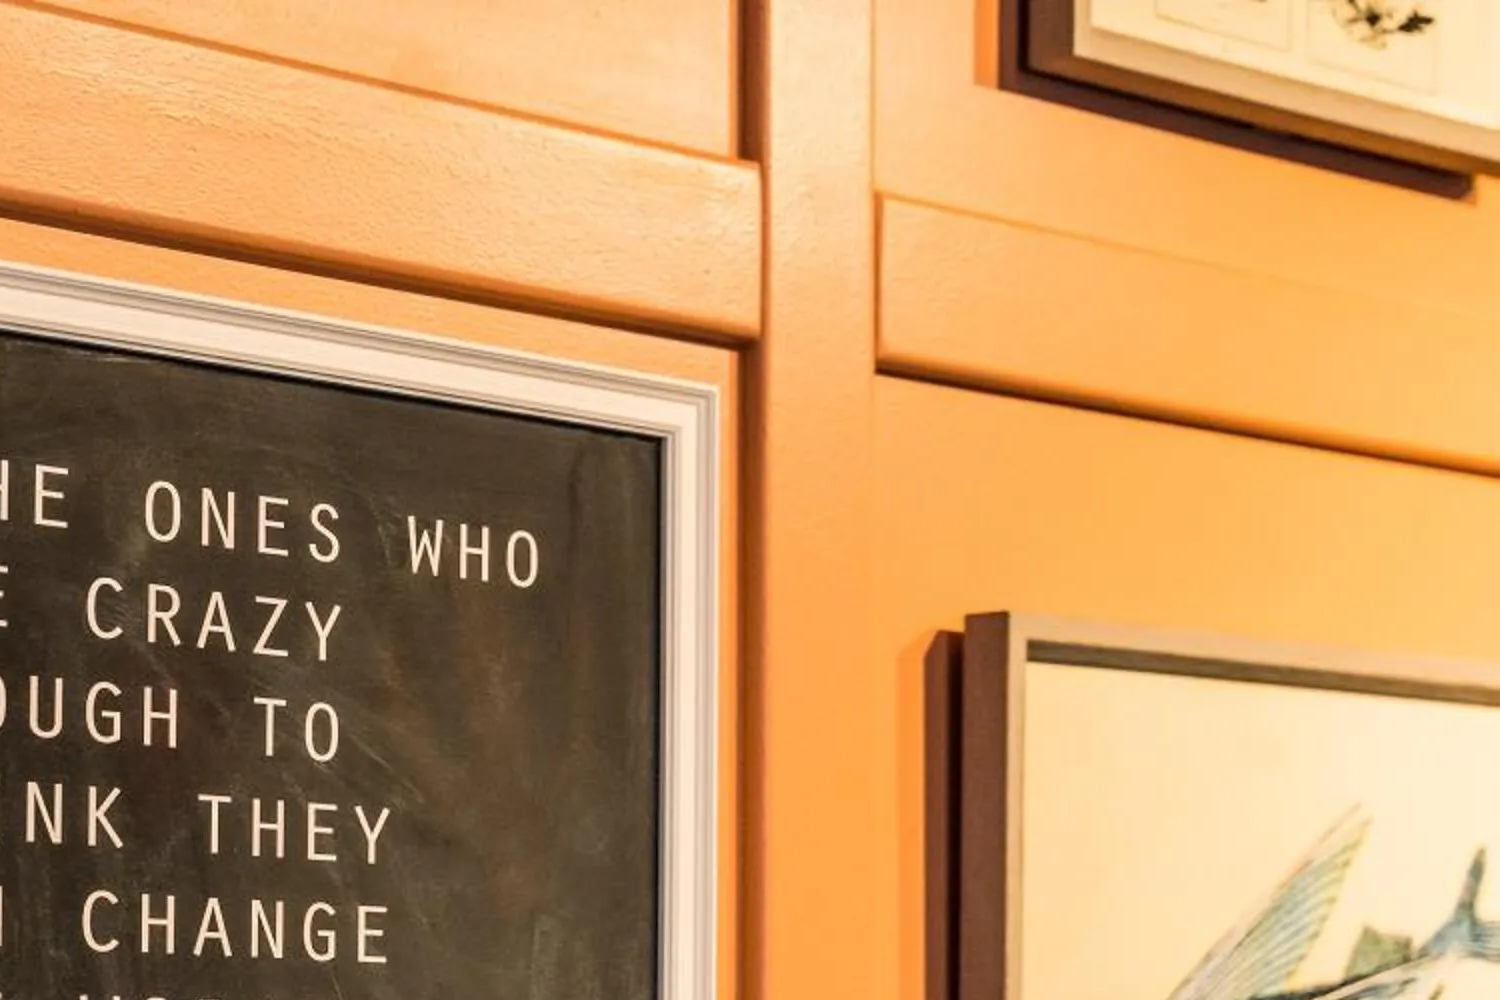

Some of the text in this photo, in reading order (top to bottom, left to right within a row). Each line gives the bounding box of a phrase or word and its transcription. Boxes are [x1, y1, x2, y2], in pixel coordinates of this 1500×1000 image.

[144, 480, 341, 563] ONES
[407, 515, 541, 589] WHO
[86, 577, 342, 662] CRAZY
[253, 696, 339, 763] TO
[197, 793, 391, 865] THEY
[82, 889, 389, 964] CHANGE
